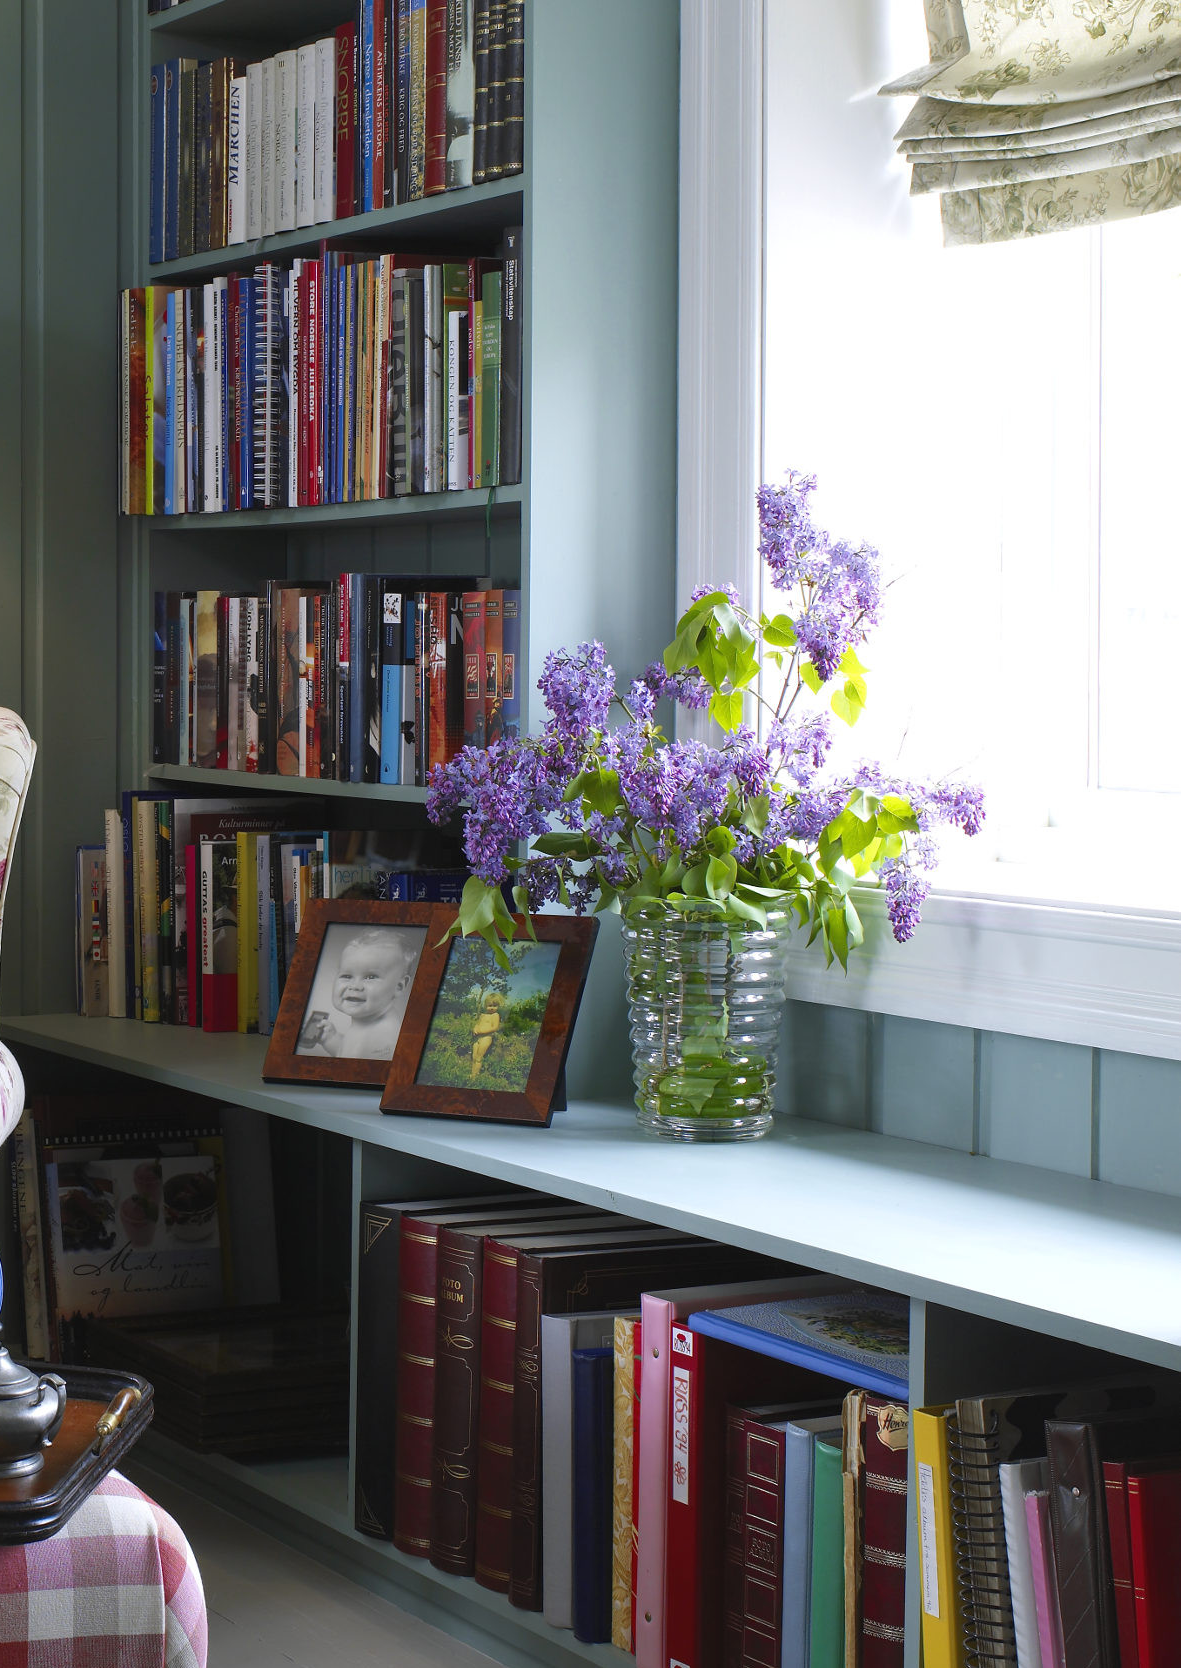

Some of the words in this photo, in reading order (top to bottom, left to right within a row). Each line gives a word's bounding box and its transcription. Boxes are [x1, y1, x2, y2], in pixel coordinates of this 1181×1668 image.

[363, 42, 373, 79] Norge
[397, 27, 406, 76] ROMERIKE
[336, 36, 349, 142] SNORRE
[375, 50, 383, 108] ANTIKKENS
[397, 87, 406, 111] KRIG
[363, 88, 374, 158] dansketiden
[375, 112, 383, 162] HISTORIE
[397, 113, 406, 128] OG
[397, 129, 405, 154] FRED
[308, 280, 316, 316] STORE
[507, 259, 516, 322] Statsvitenskap
[308, 318, 316, 364] NORSKE
[448, 339, 456, 395] KONGEN
[176, 378, 185, 449] FREDSPRIS
[308, 367, 316, 422] JULEBOKA
[448, 397, 456, 414] OG
[448, 415, 456, 463] KATTEN
[414, 619, 421, 639] JO
[218, 818, 273, 828] Kulturminner
[91, 1287, 111, 1312] og
[674, 1376, 688, 1424] RUSS
[921, 1506, 930, 1542] album
